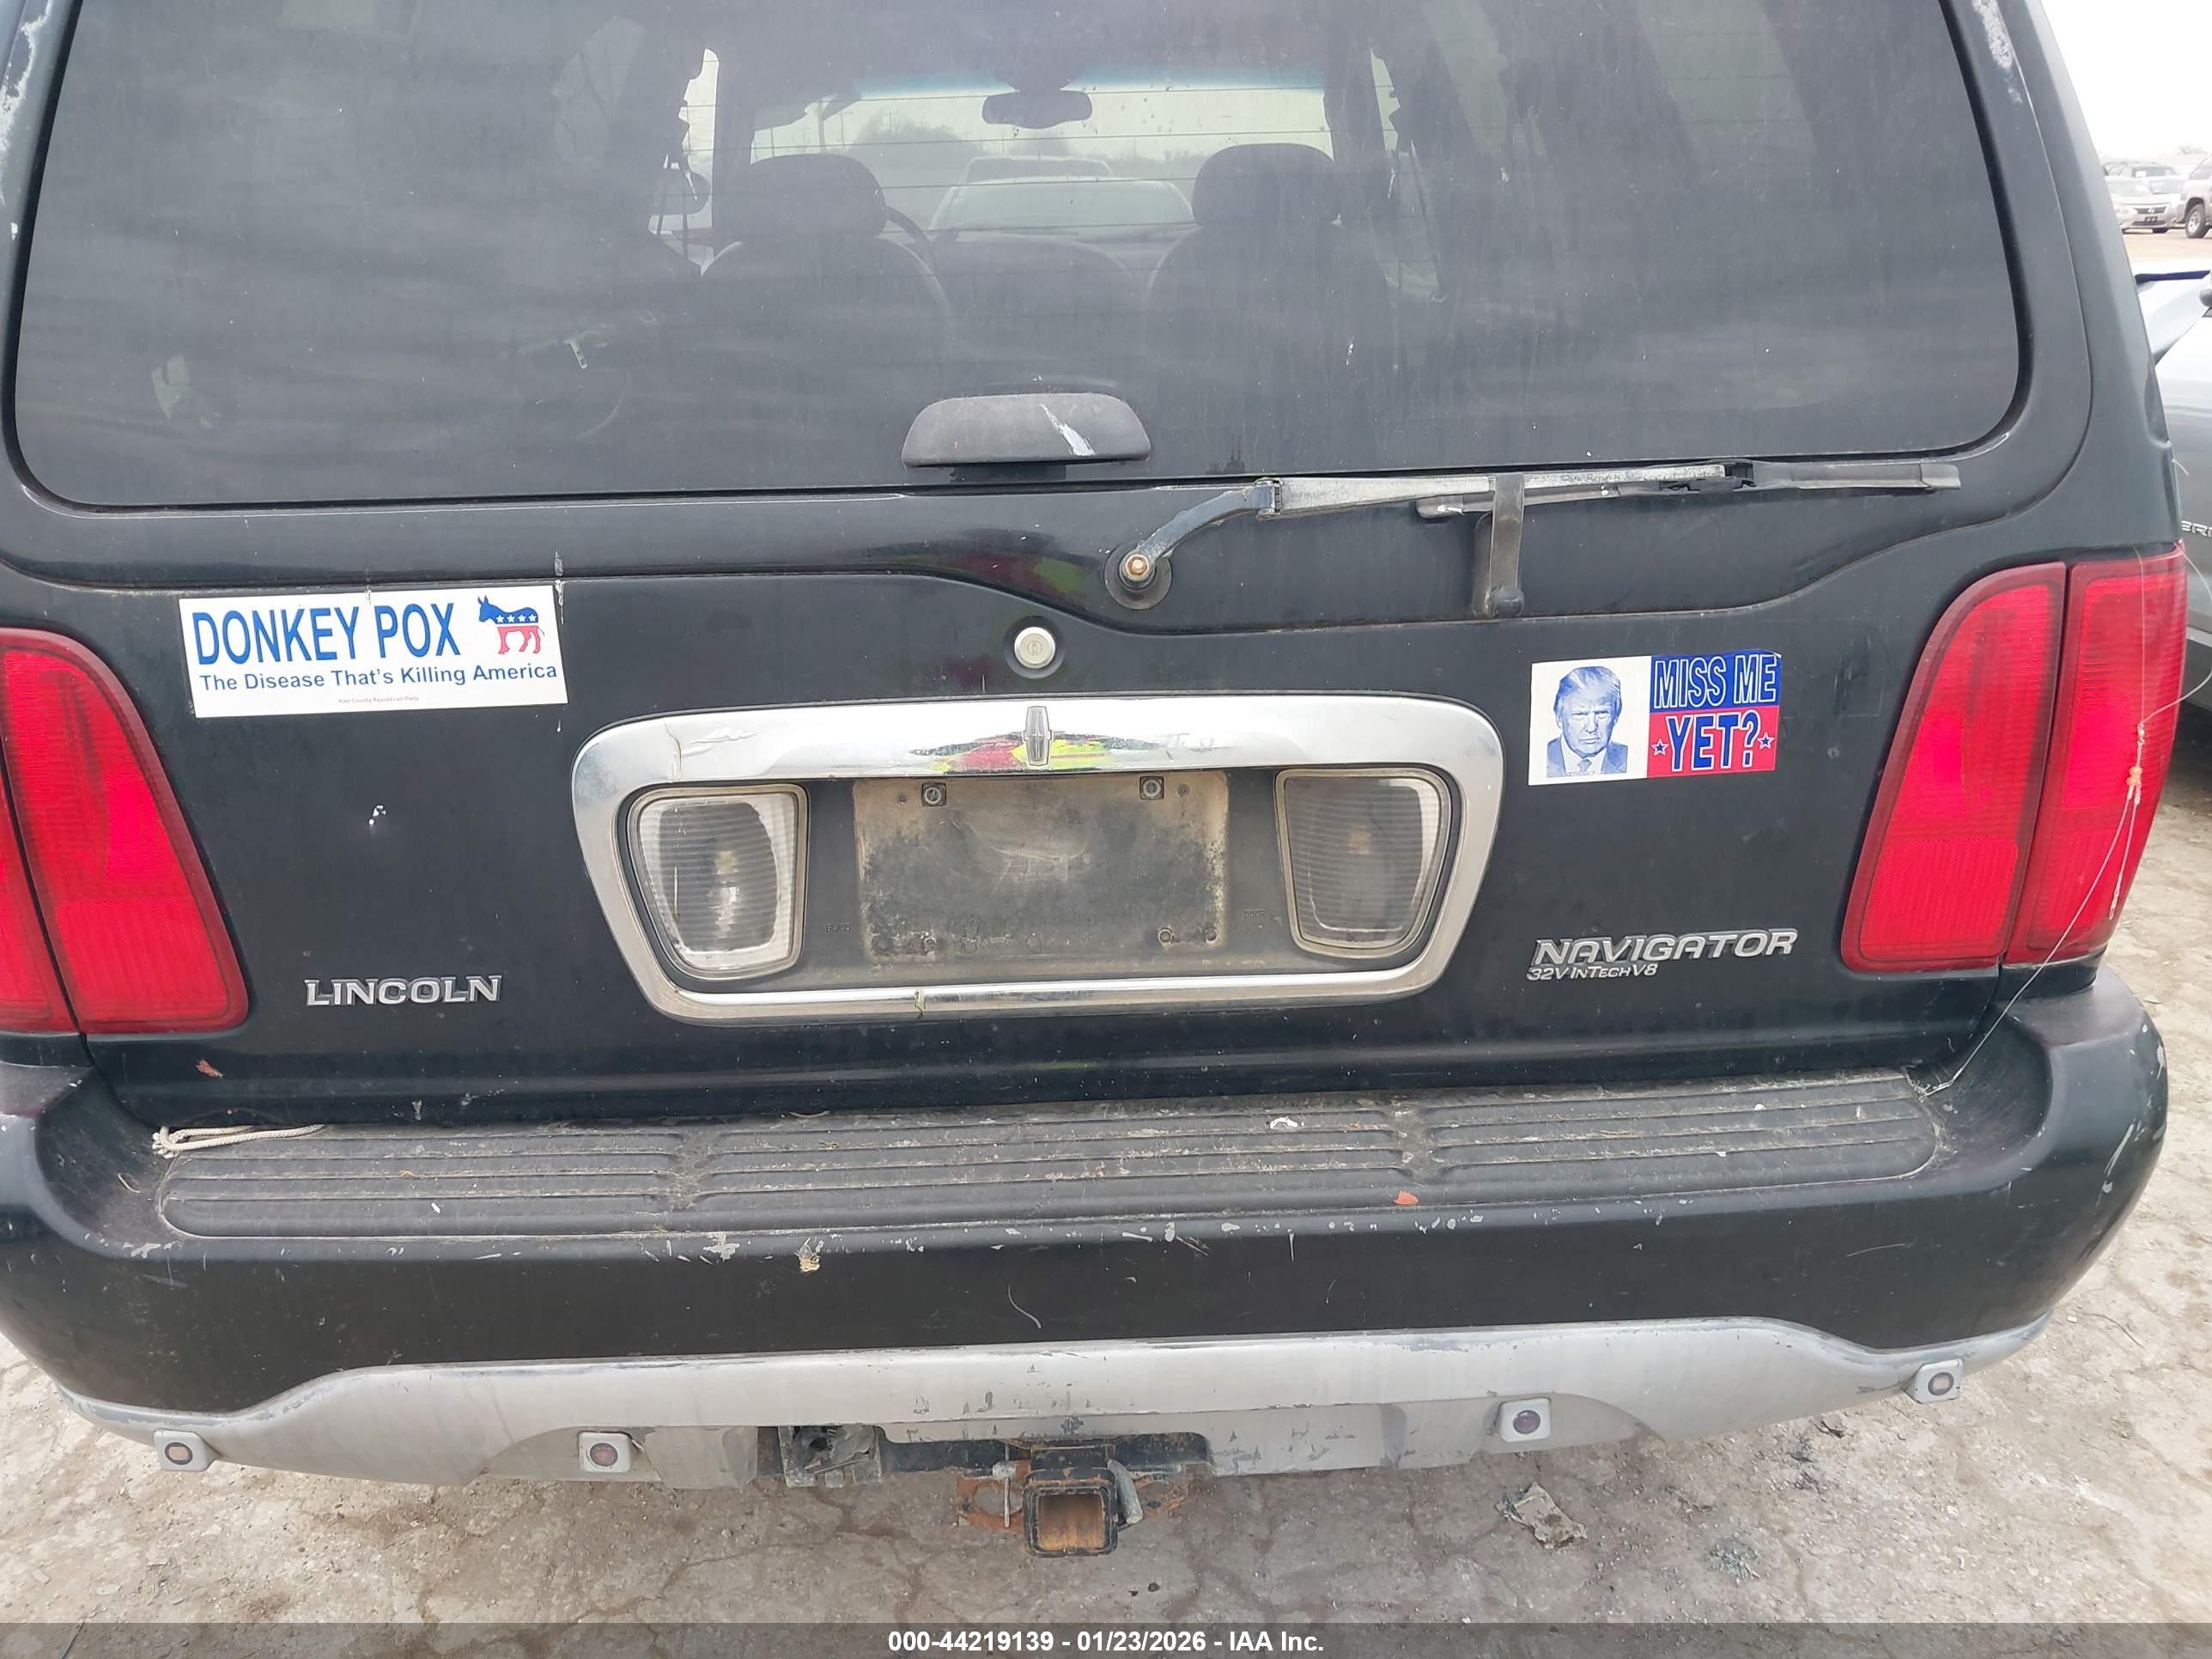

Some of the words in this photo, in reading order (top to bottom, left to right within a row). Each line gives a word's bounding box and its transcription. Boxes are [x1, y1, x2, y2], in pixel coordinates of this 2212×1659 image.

[191, 606, 360, 665] DONKEY
[374, 603, 461, 659] POX
[200, 674, 239, 691] The
[246, 672, 325, 690] Disease
[331, 668, 394, 686] That's
[401, 665, 466, 686] Killing
[473, 662, 557, 682] America
[1652, 655, 1727, 709] MISS
[1733, 653, 1778, 704] ME
[1666, 709, 1761, 773] YET?
[1530, 927, 1799, 966] NAVIGATOR
[304, 975, 502, 1006] LINCOLN
[1527, 965, 1571, 981] 32V
[1631, 963, 1659, 977] V8
